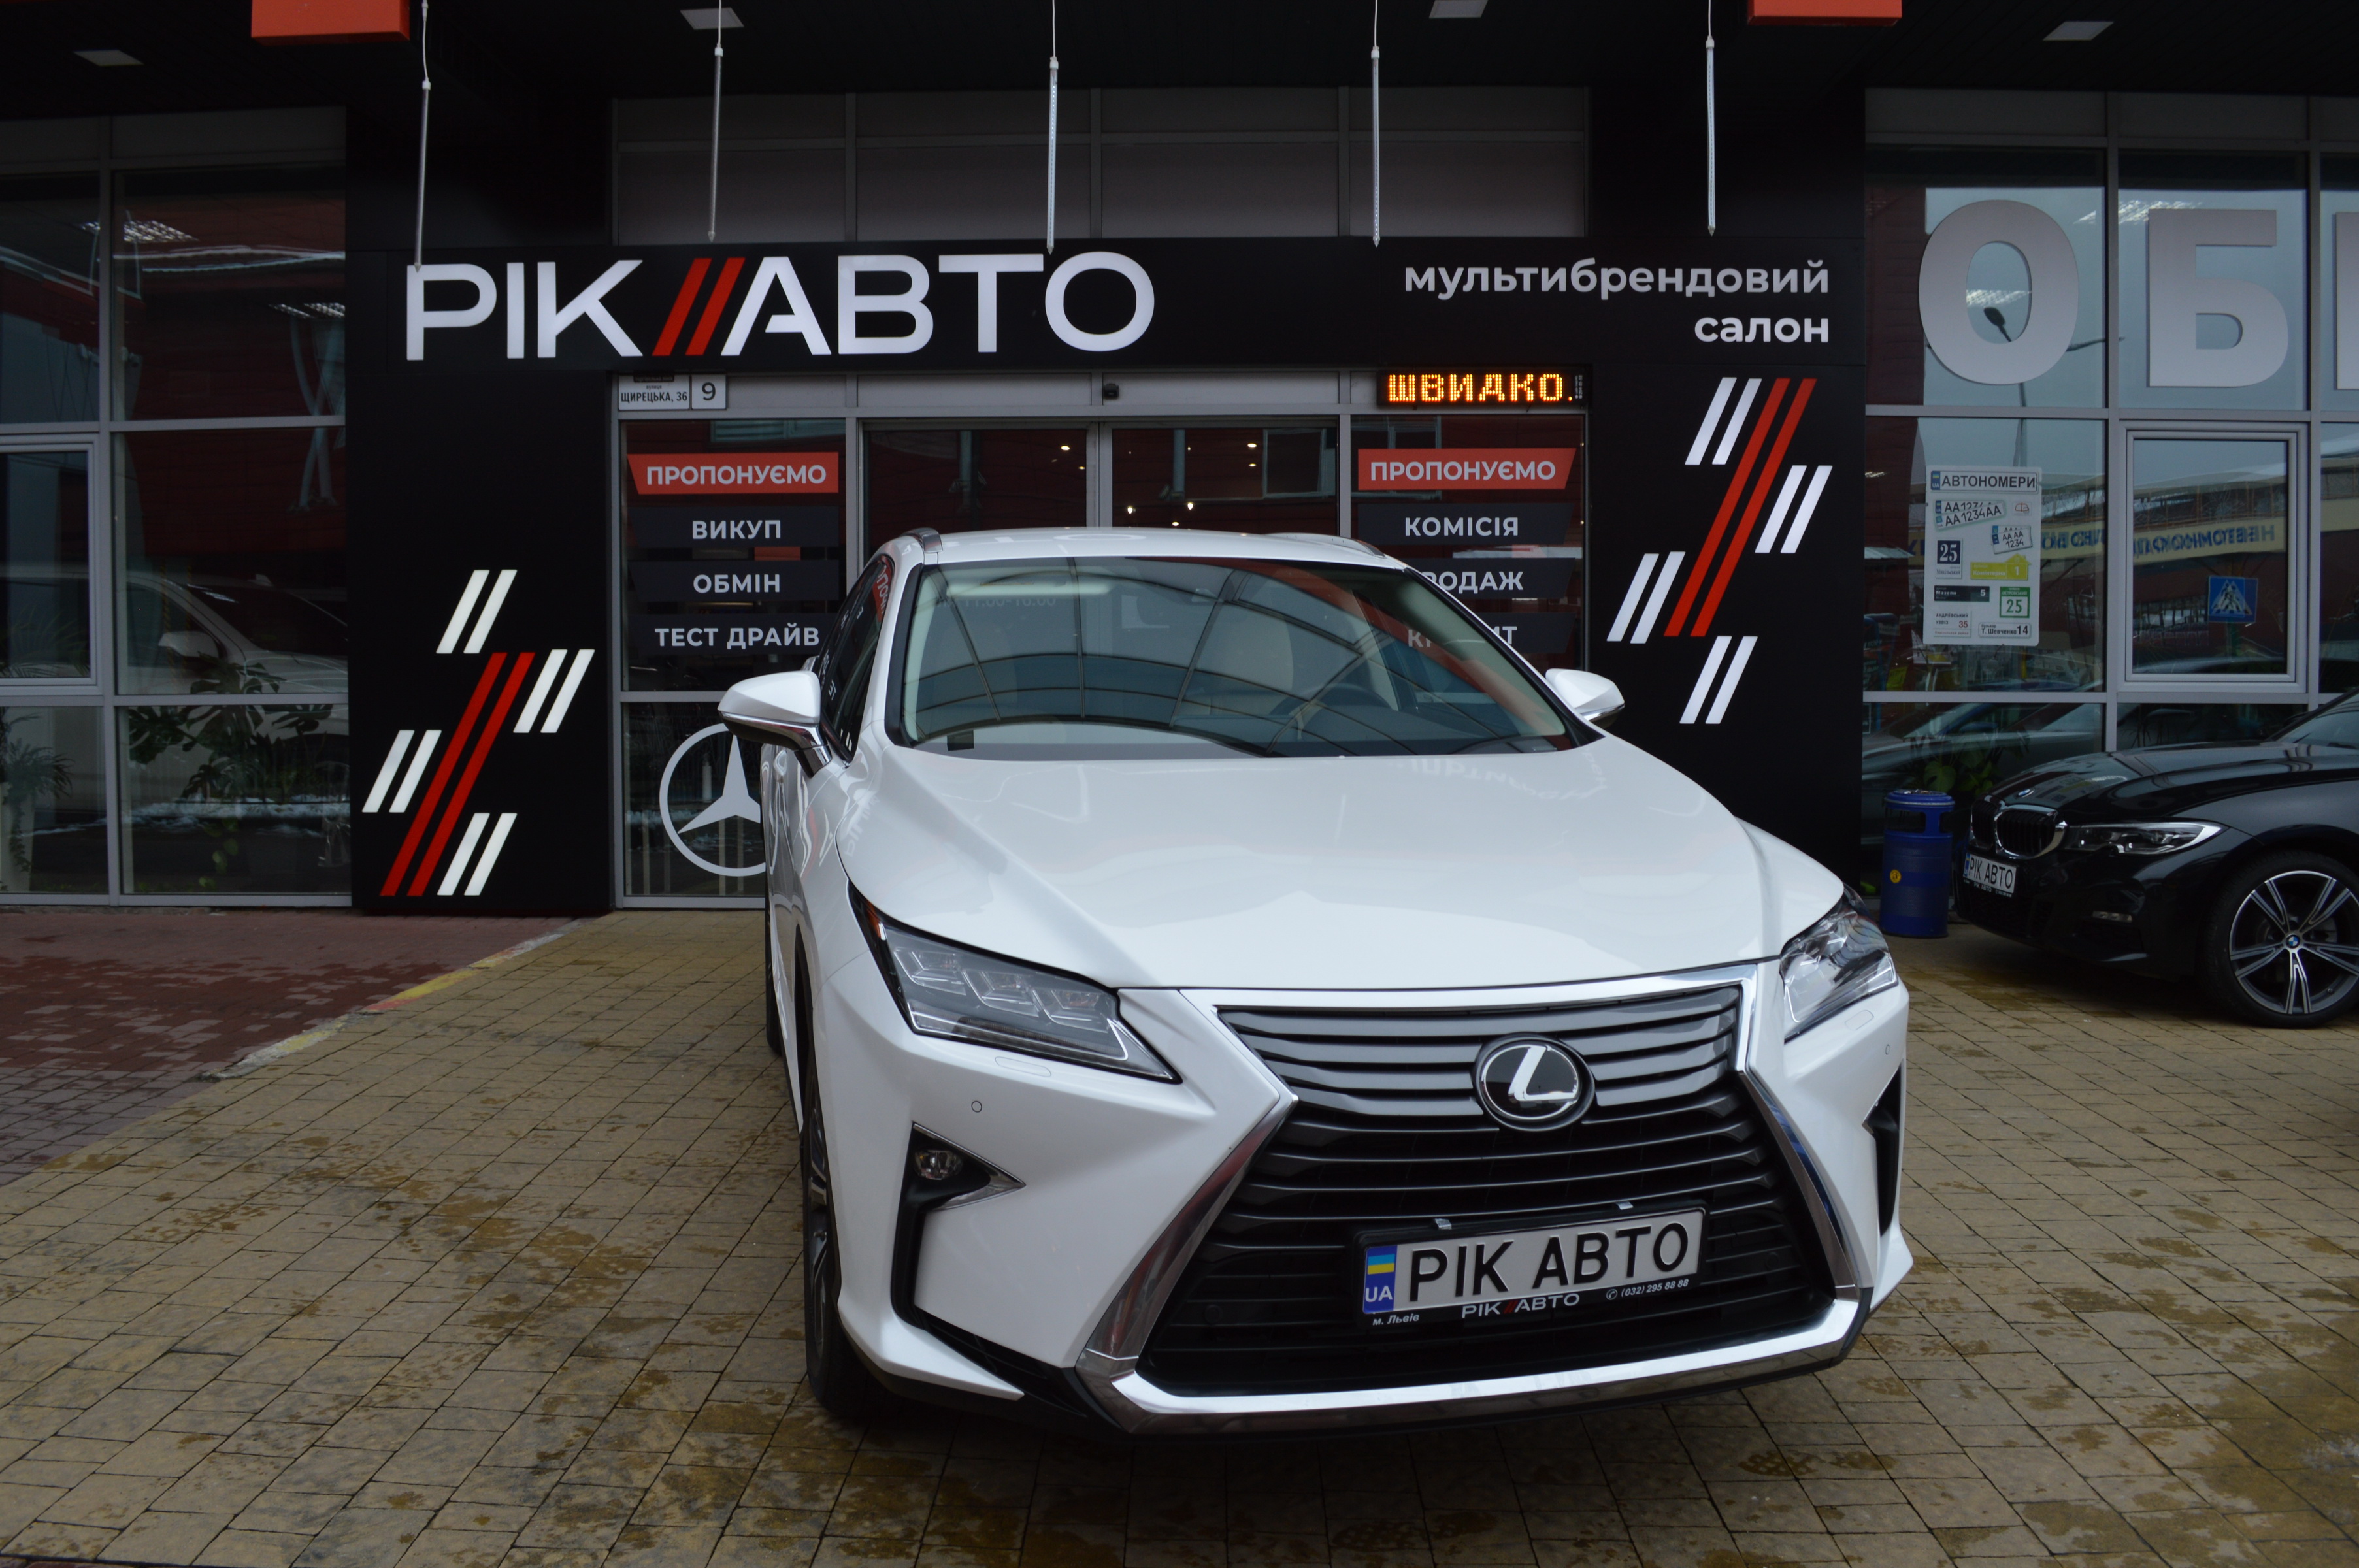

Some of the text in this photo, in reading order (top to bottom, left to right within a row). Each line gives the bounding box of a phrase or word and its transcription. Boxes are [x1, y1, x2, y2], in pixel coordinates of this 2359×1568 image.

[1405, 257, 1828, 301] мультибрендовий
[406, 251, 1155, 361] РІК АВТО
[1694, 316, 1828, 343] салон
[621, 391, 687, 403] ЩИРЕЦЬКА, 36
[701, 382, 716, 400] 9
[1388, 373, 1573, 402] ШВИДКО.
[647, 465, 826, 485] ПРОПОНУЄМО
[1371, 461, 1555, 481] ПРОПОНУЄМО
[1942, 476, 2035, 488] АВТОНОМЕРИ
[692, 520, 781, 540] ВИКУП
[1405, 517, 1518, 536] КОМІСІЯ
[2005, 538, 2024, 548] 1234
[1939, 544, 1958, 563] 25
[2015, 566, 2019, 575] 1
[693, 574, 780, 593] ОБМІН
[1421, 571, 1523, 594] РОДАЖ
[2006, 599, 2022, 613] 25
[655, 623, 819, 649] ТЕСТ ДРАЙВ
[2017, 625, 2028, 635] 14
[1968, 857, 2013, 889] РІК АВТО
[1408, 1222, 1689, 1302] РІК АВТО
[1365, 1285, 1393, 1302] UA
[1621, 1279, 1689, 1298] (032) 295 88 88
[1462, 1293, 1580, 1318] РІК АВТО
[1387, 1313, 1420, 1324] Львів
